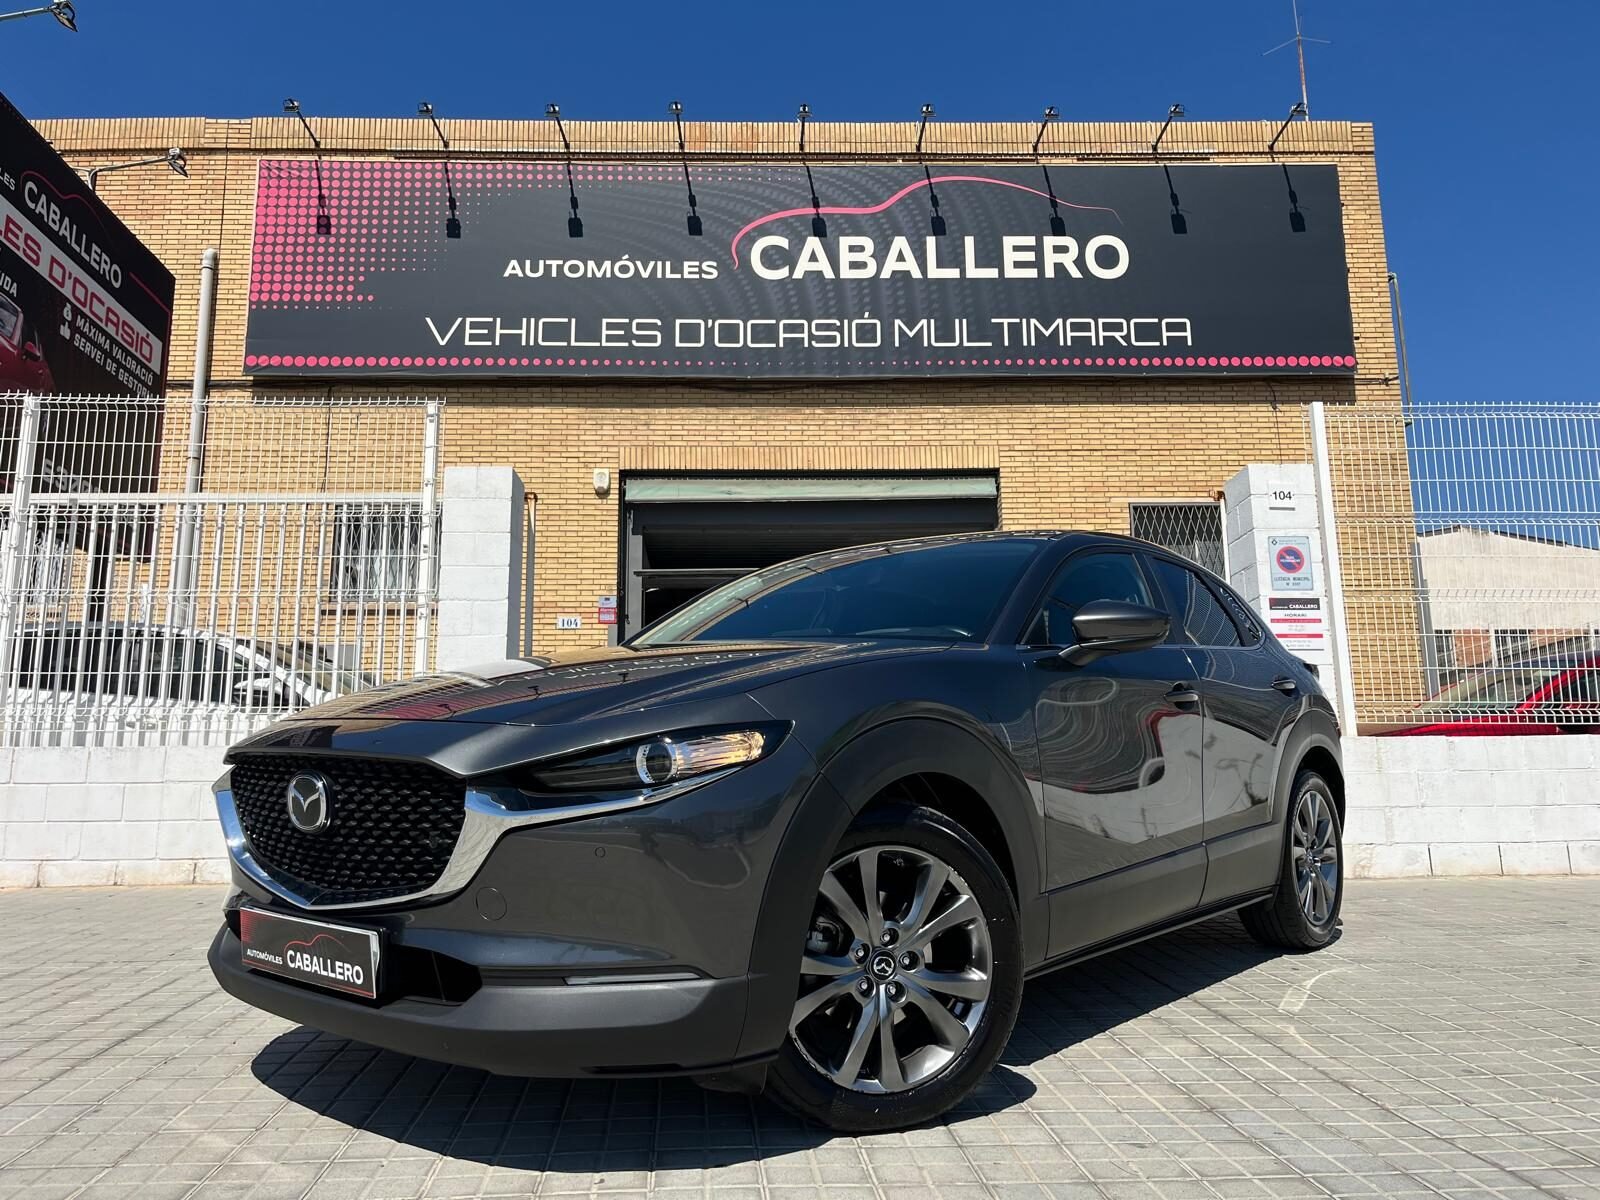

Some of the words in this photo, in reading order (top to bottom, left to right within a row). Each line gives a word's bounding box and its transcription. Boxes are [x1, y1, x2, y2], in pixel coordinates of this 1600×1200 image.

[24, 181, 122, 289] CABALLERO
[503, 254, 718, 279] AUTOMÓVILES
[750, 235, 1130, 280] CABALLERO
[0, 214, 41, 267] ES
[48, 254, 154, 364] D'OCASIÓ
[425, 317, 662, 348] VEHICLES
[674, 312, 881, 348] D'OCASIÓ
[893, 317, 1193, 348] MULTIMARCA
[73, 333, 105, 366] SERVEI
[106, 358, 118, 376] DE
[112, 343, 154, 386] VALORACIÓ
[1272, 491, 1292, 501] 104
[561, 618, 579, 628] 104
[246, 948, 283, 965] AUTOMÓVILES
[286, 950, 364, 985] CABALLERO
